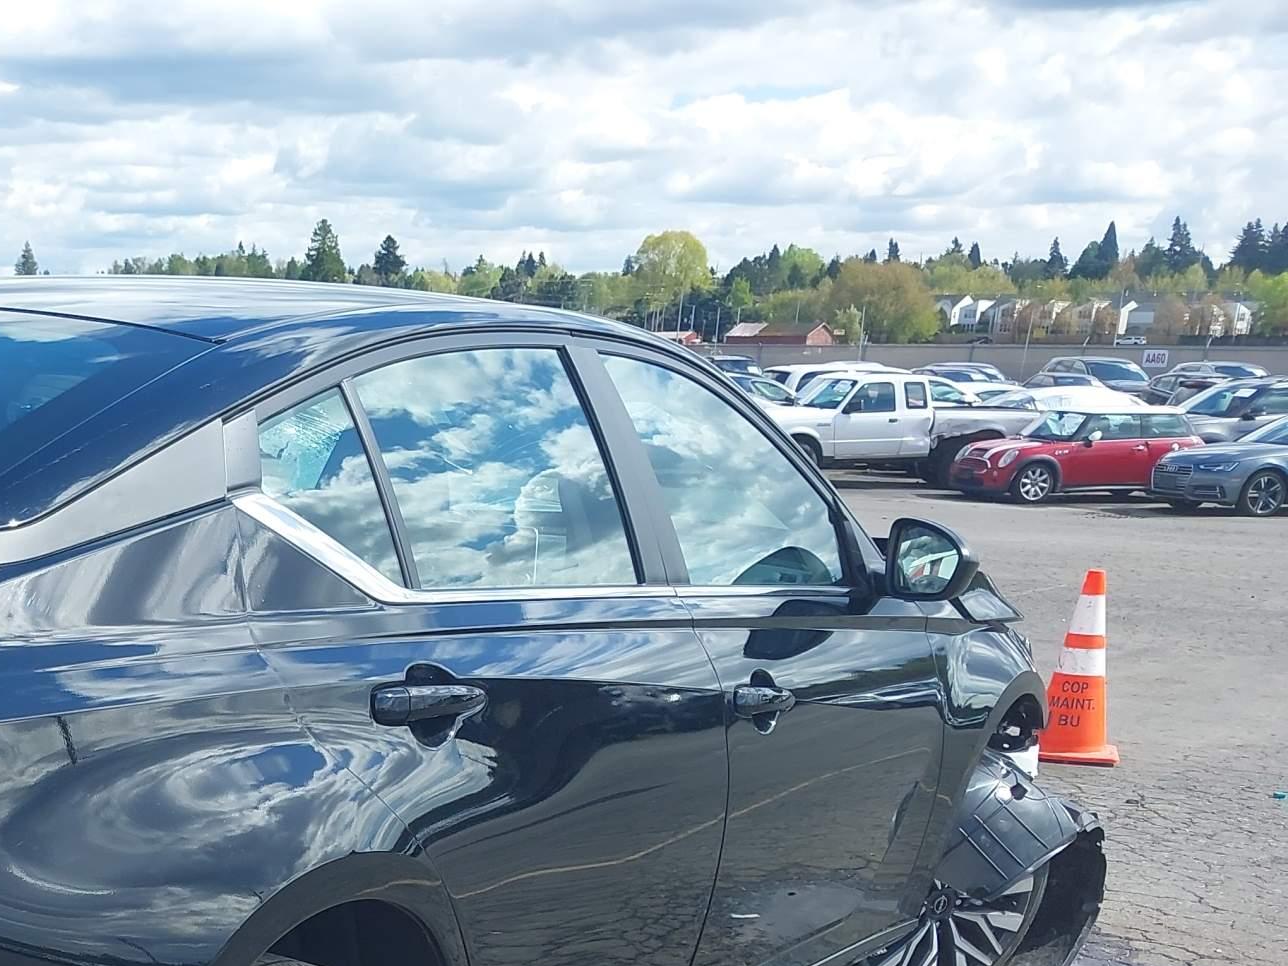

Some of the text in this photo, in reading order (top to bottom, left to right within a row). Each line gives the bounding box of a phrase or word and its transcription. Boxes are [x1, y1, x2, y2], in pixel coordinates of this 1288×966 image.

[1061, 680, 1089, 694] COP
[1048, 695, 1096, 711] MAINT.
[1057, 713, 1081, 728] BU
